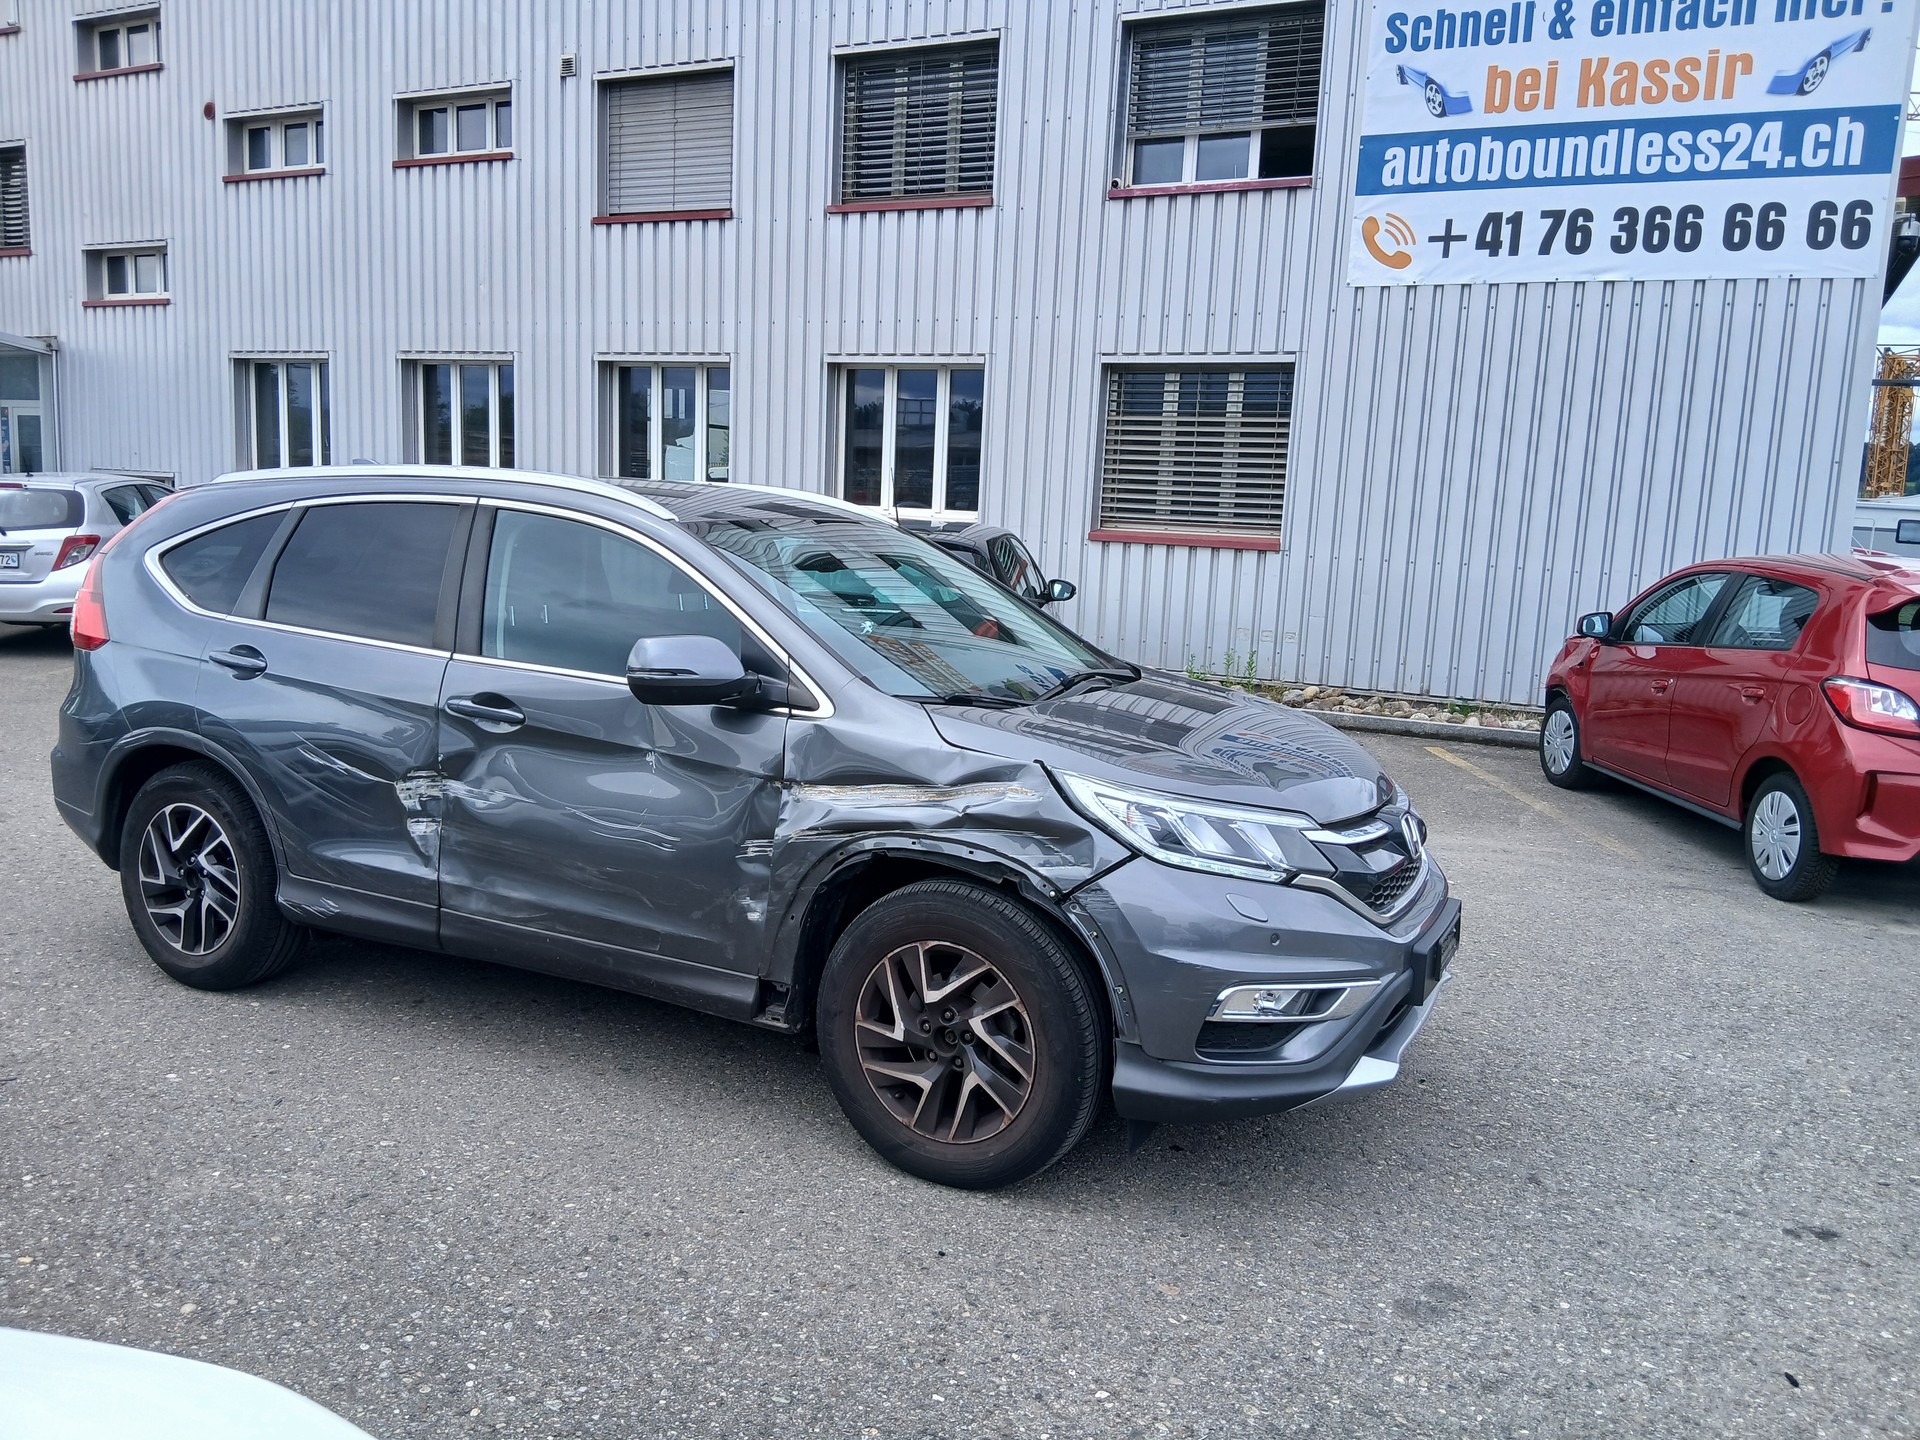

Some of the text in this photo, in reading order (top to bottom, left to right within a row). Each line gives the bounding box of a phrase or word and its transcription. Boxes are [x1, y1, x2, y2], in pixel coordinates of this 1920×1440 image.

[1385, 0, 1535, 53] Schnell
[1548, 0, 1576, 40] &
[1590, 0, 1756, 37] einfach
[1484, 49, 1754, 114] bei Kassir
[1381, 116, 1865, 187] autoboundless24.ch
[1537, 208, 1594, 255] 76
[1610, 204, 1704, 254] 366
[1722, 201, 1787, 251] 66
[1805, 199, 1874, 250] 66
